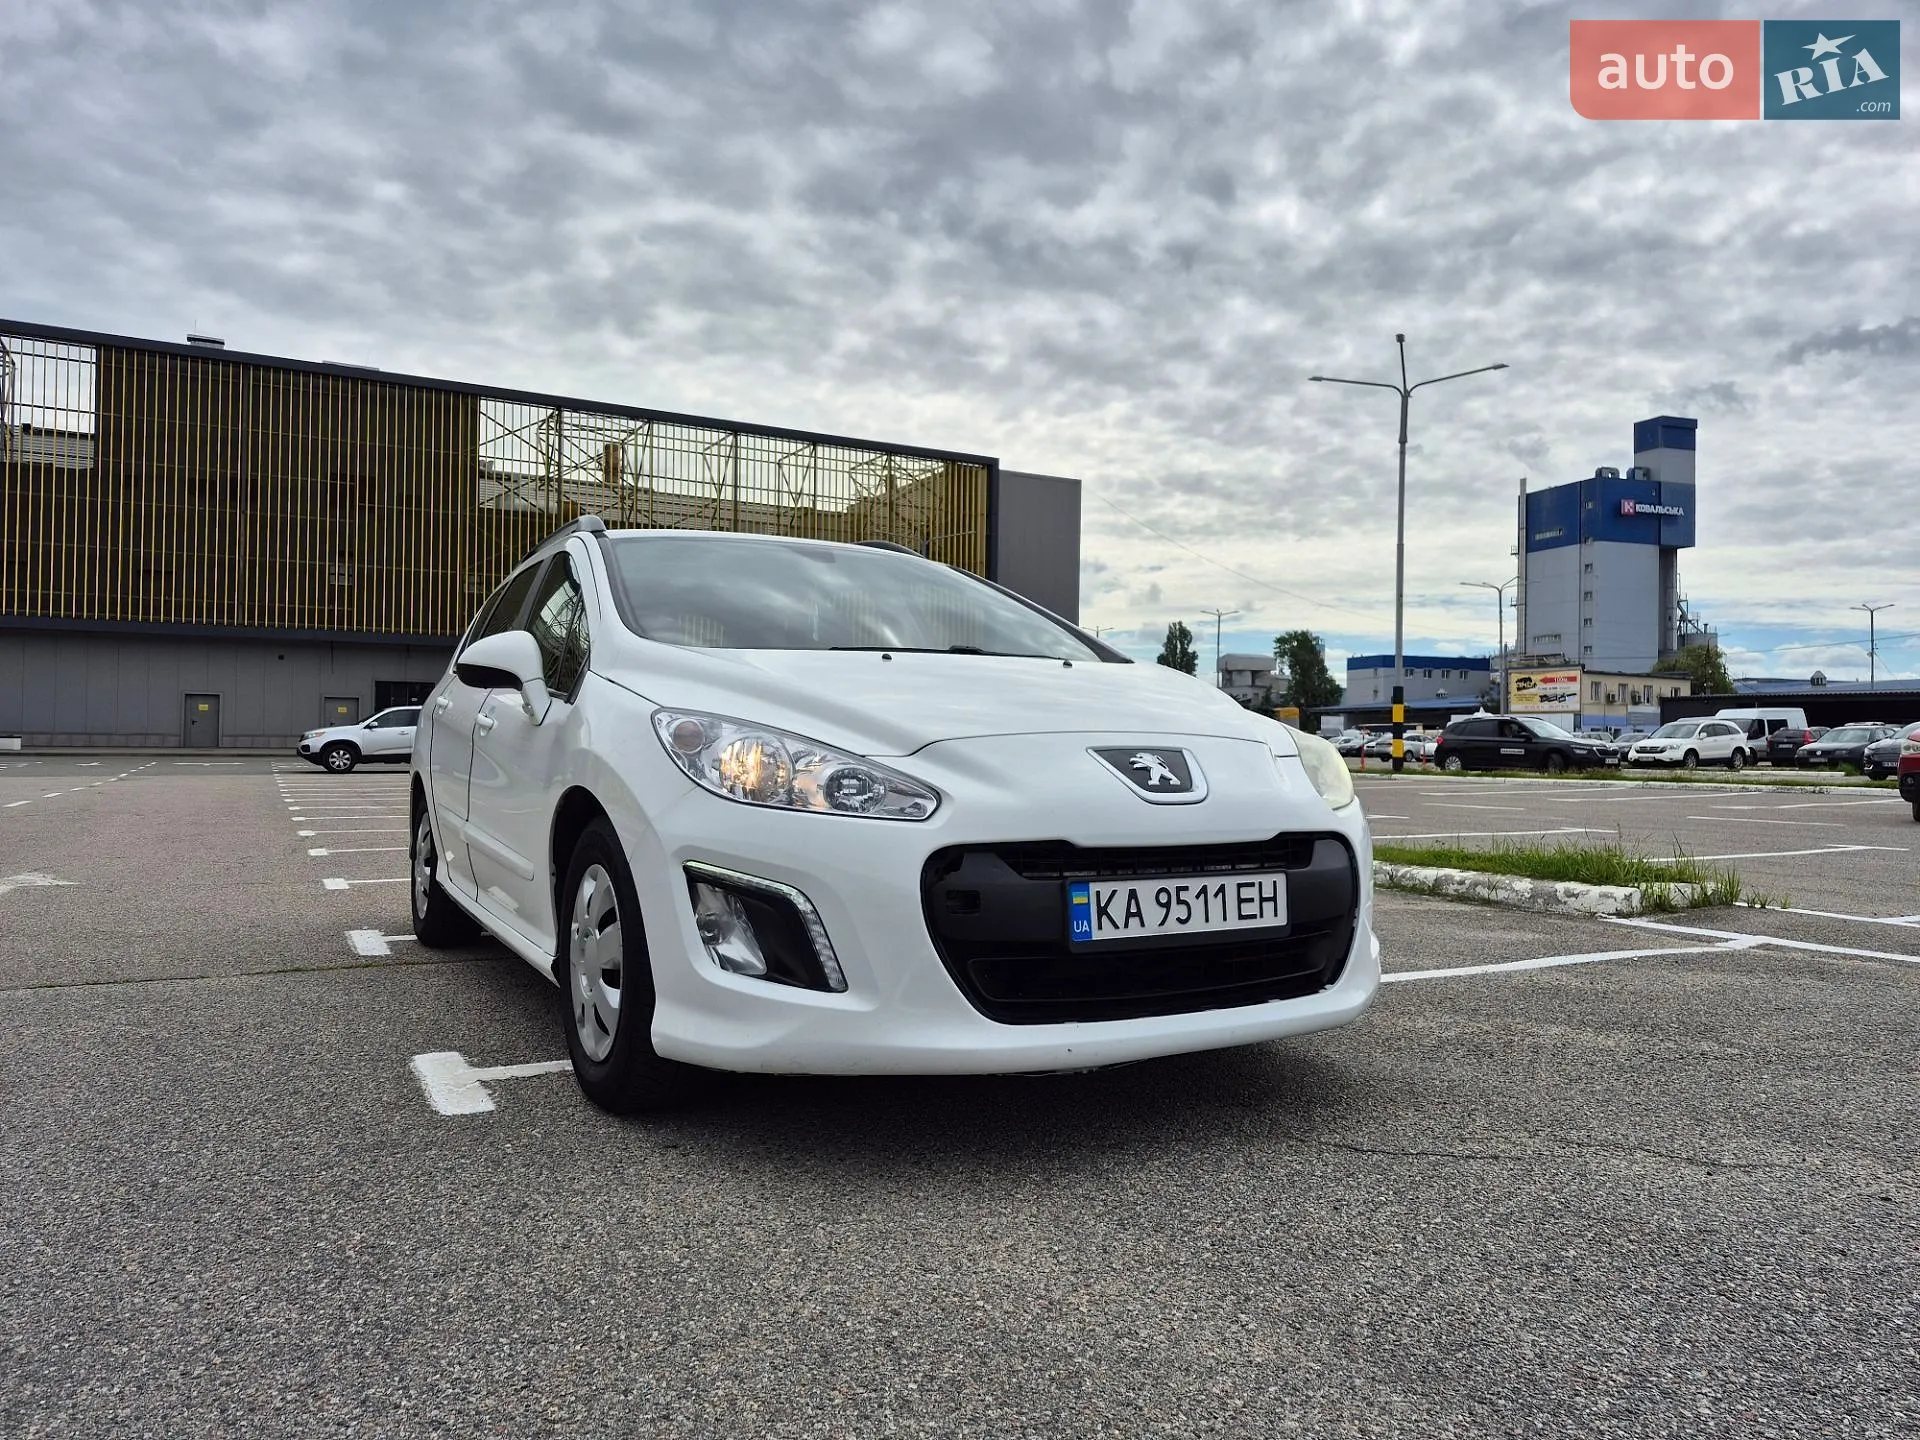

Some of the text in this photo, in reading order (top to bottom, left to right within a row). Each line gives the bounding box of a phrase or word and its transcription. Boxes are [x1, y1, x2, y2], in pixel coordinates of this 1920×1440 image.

[1635, 503, 1684, 516] КОВАЛЬСЬКА
[1095, 880, 1279, 931] KA 9511 EH
[1073, 920, 1090, 933] UA
